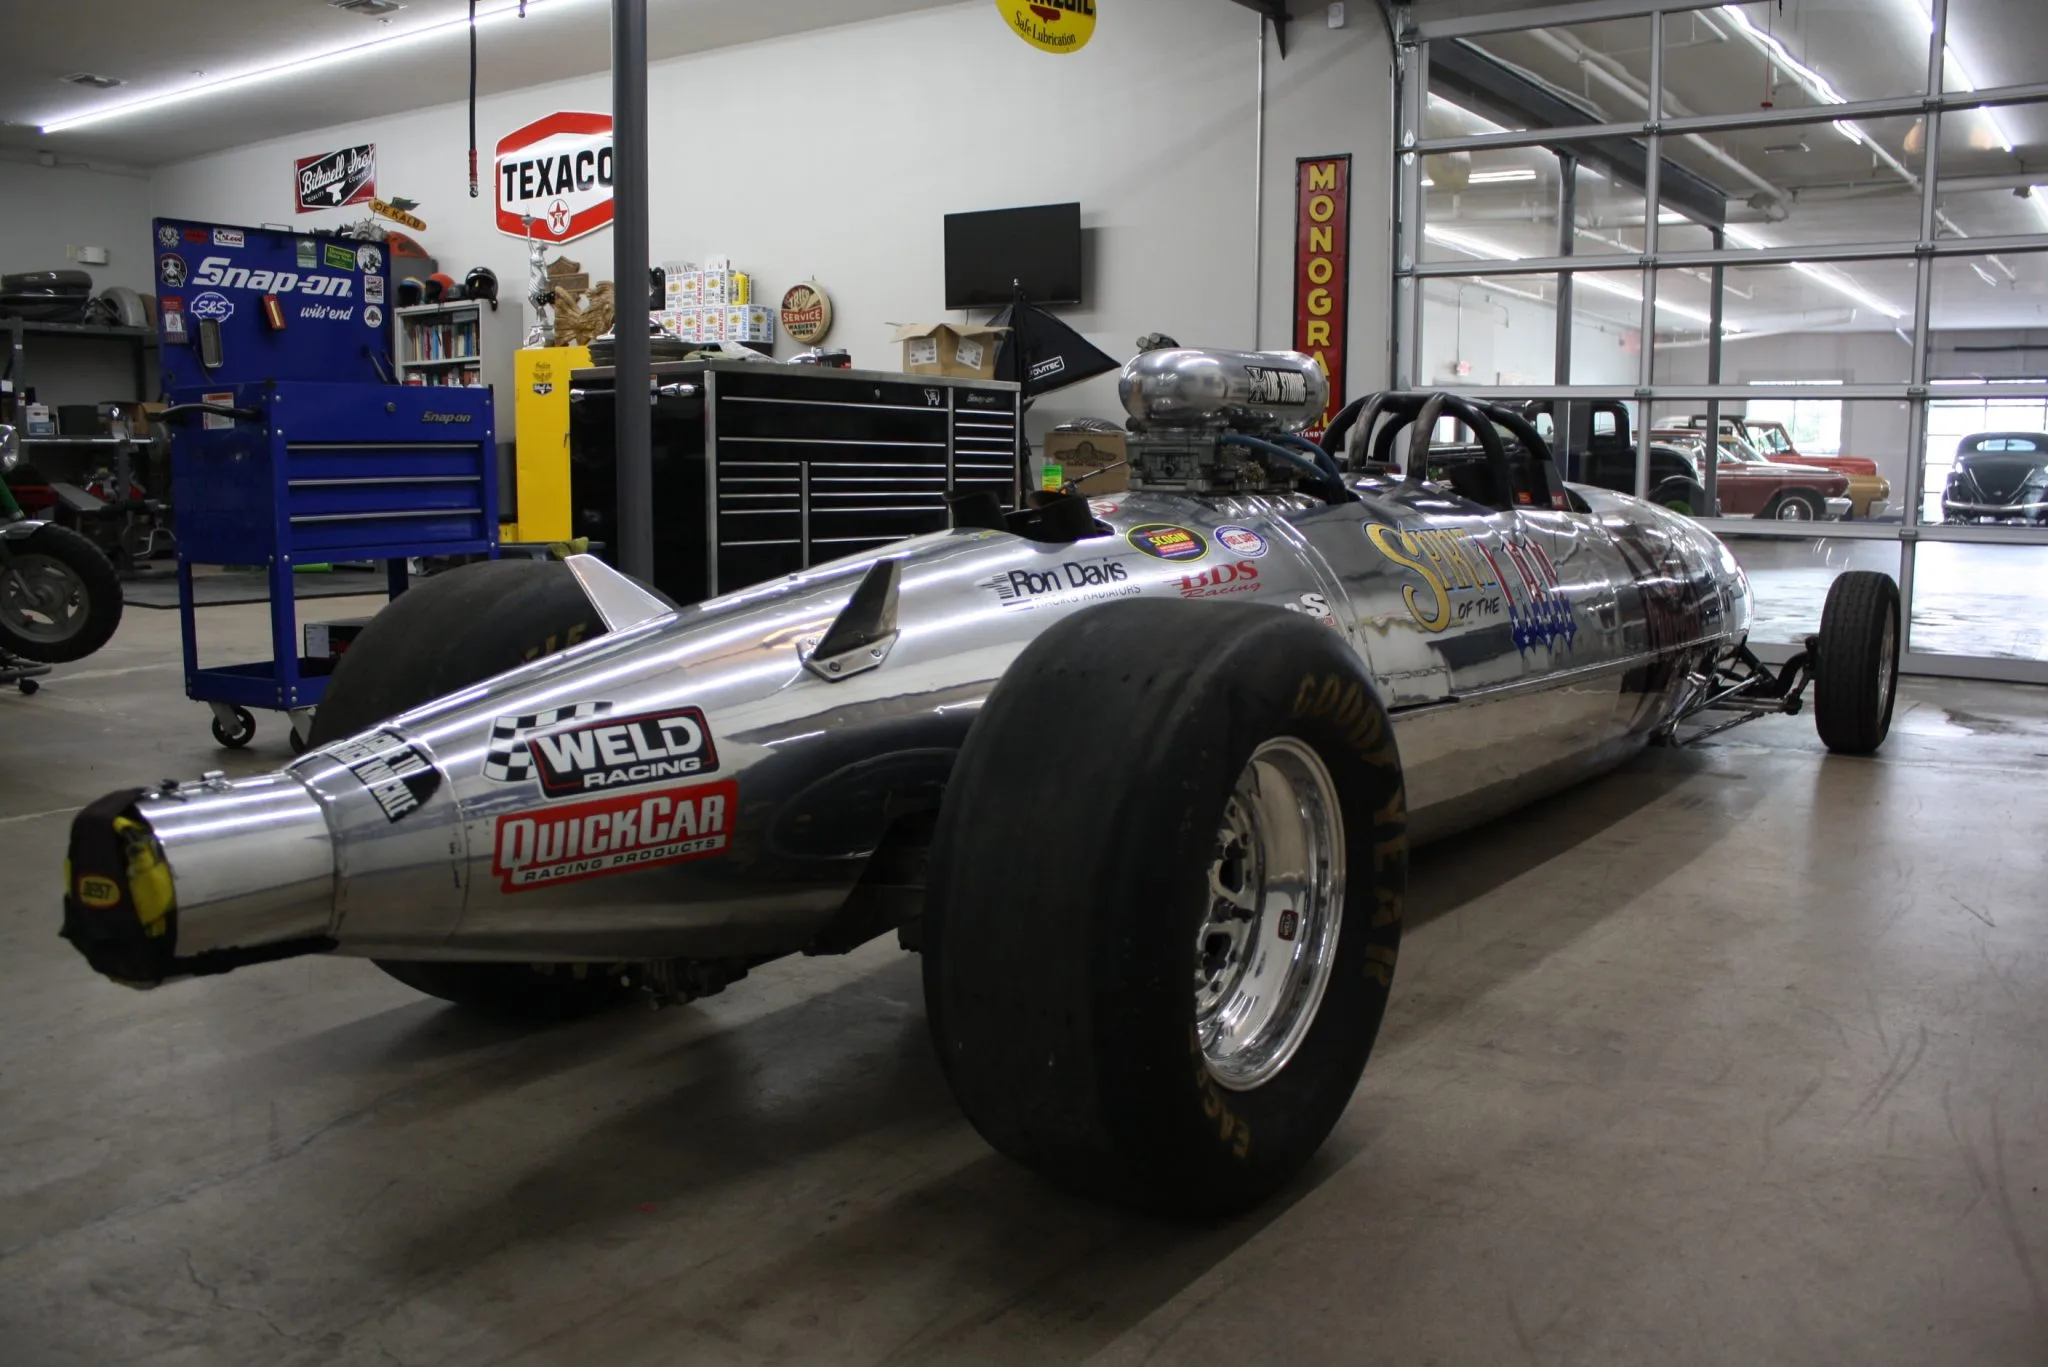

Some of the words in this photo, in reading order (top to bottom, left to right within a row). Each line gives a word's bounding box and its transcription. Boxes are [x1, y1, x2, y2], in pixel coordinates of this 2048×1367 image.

[1014, 10, 1032, 36] Safe
[1032, 23, 1077, 47] Lubrication
[302, 154, 345, 196] Biltwell
[502, 146, 613, 203] TEXACO
[192, 256, 352, 297] Snap-on
[1307, 163, 1336, 408] MONOGRA
[197, 300, 227, 315] S&S
[783, 310, 822, 323] SERVICE
[421, 410, 472, 425] Snap-on
[1007, 569, 1062, 598] Ron
[1063, 557, 1128, 589] Davis
[1180, 559, 1259, 590] BDS
[1180, 582, 1261, 599] Racing
[1082, 583, 1142, 602] RADIATORS
[1457, 600, 1474, 619] OF
[1475, 597, 1500, 617] THE
[535, 714, 704, 775] WELD
[583, 756, 701, 789] RACING
[523, 858, 603, 882] RACING
[612, 837, 718, 866] PRODUCTS
